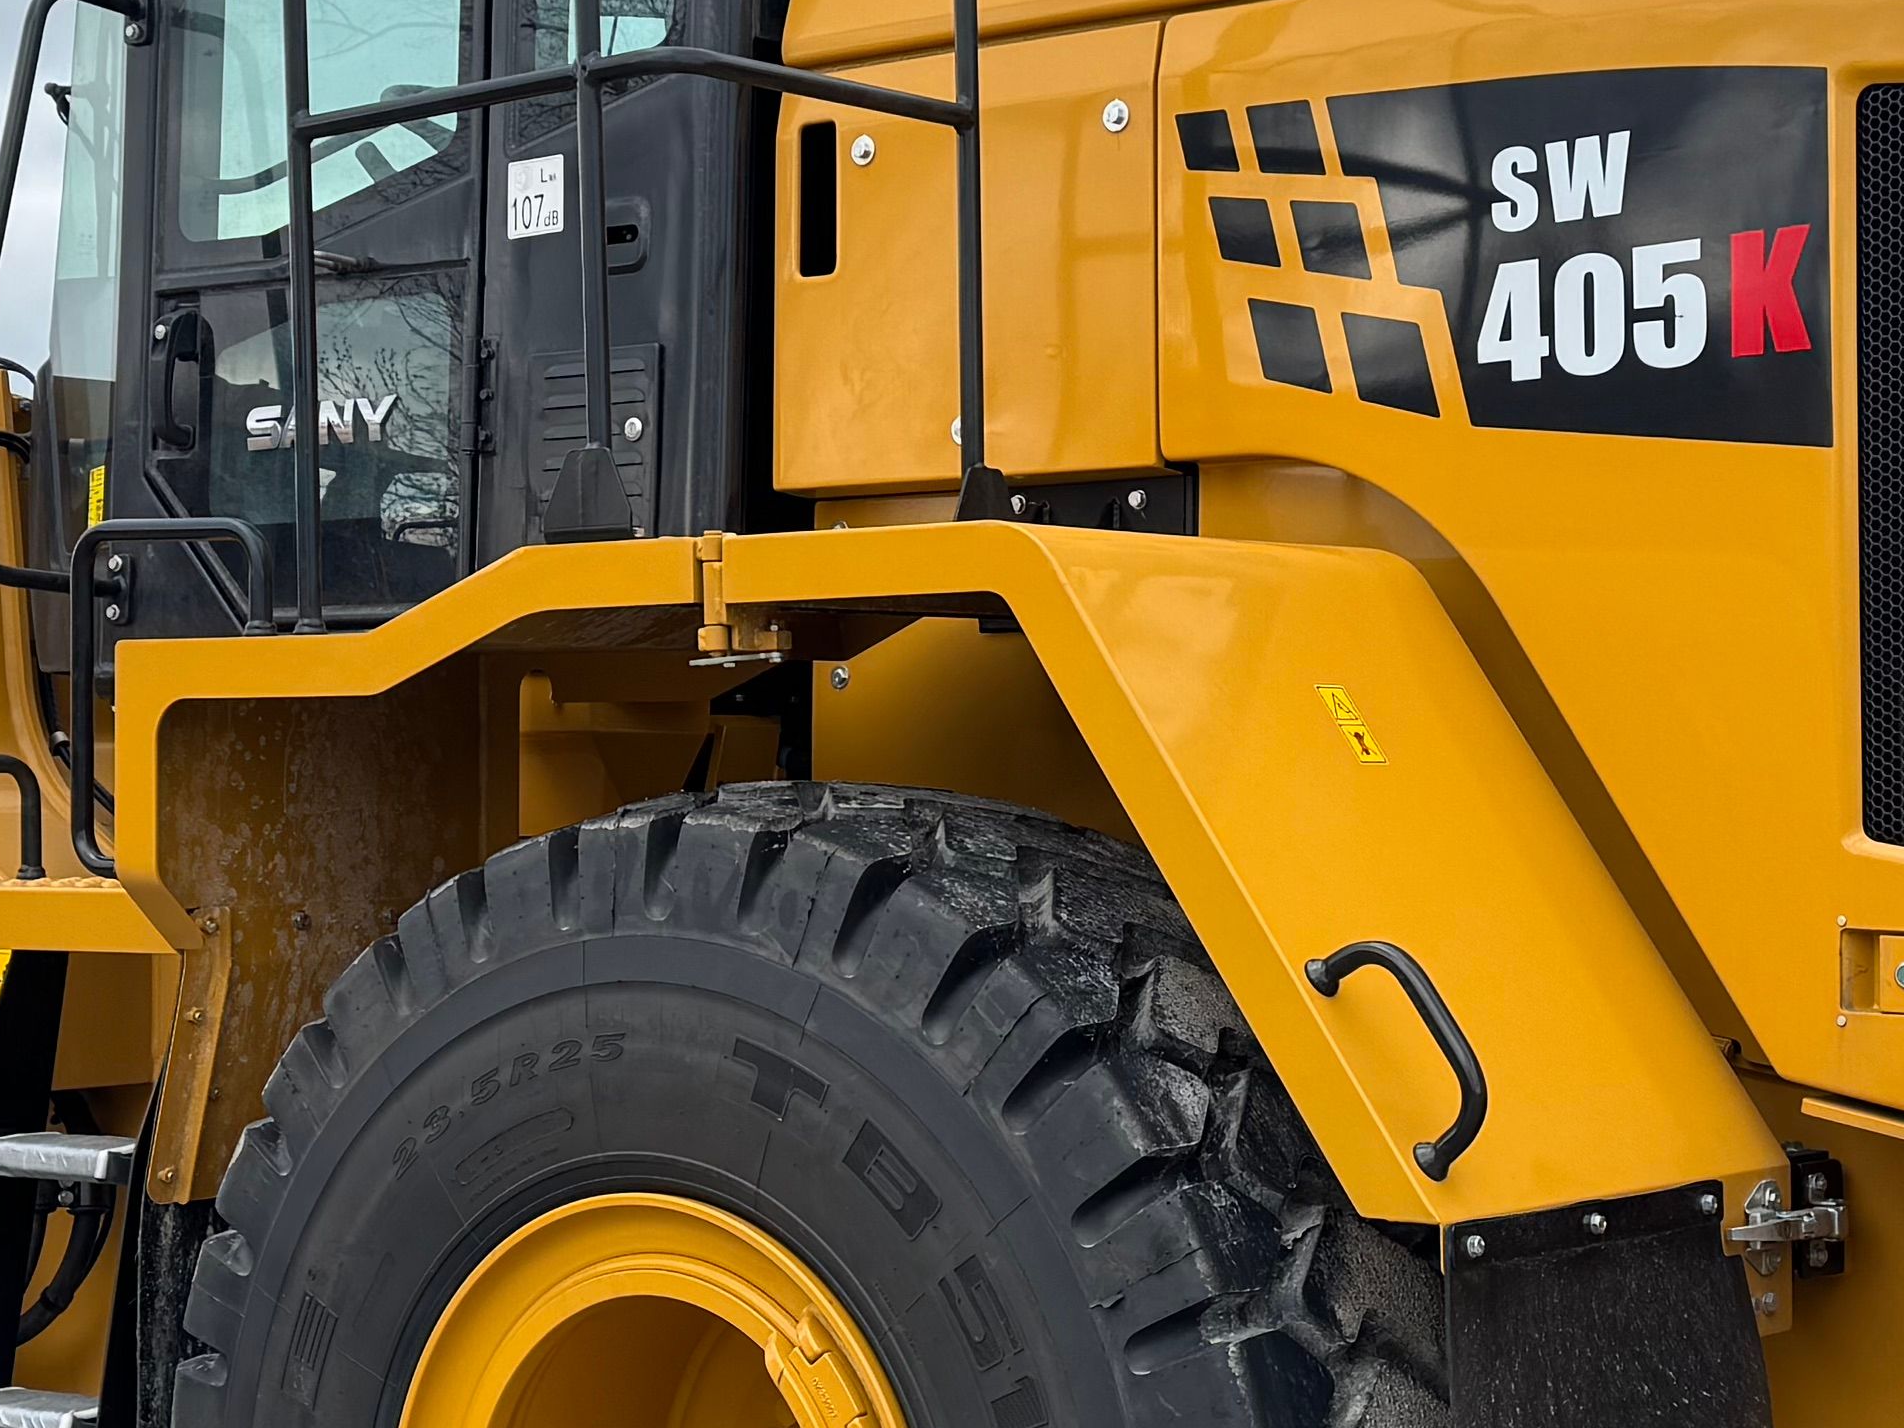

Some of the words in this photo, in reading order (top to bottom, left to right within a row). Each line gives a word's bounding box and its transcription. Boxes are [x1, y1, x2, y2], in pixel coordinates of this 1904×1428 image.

[512, 193, 545, 231] 107
[1490, 129, 1632, 233] SW
[391, 1031, 627, 1181] 23.5R25
